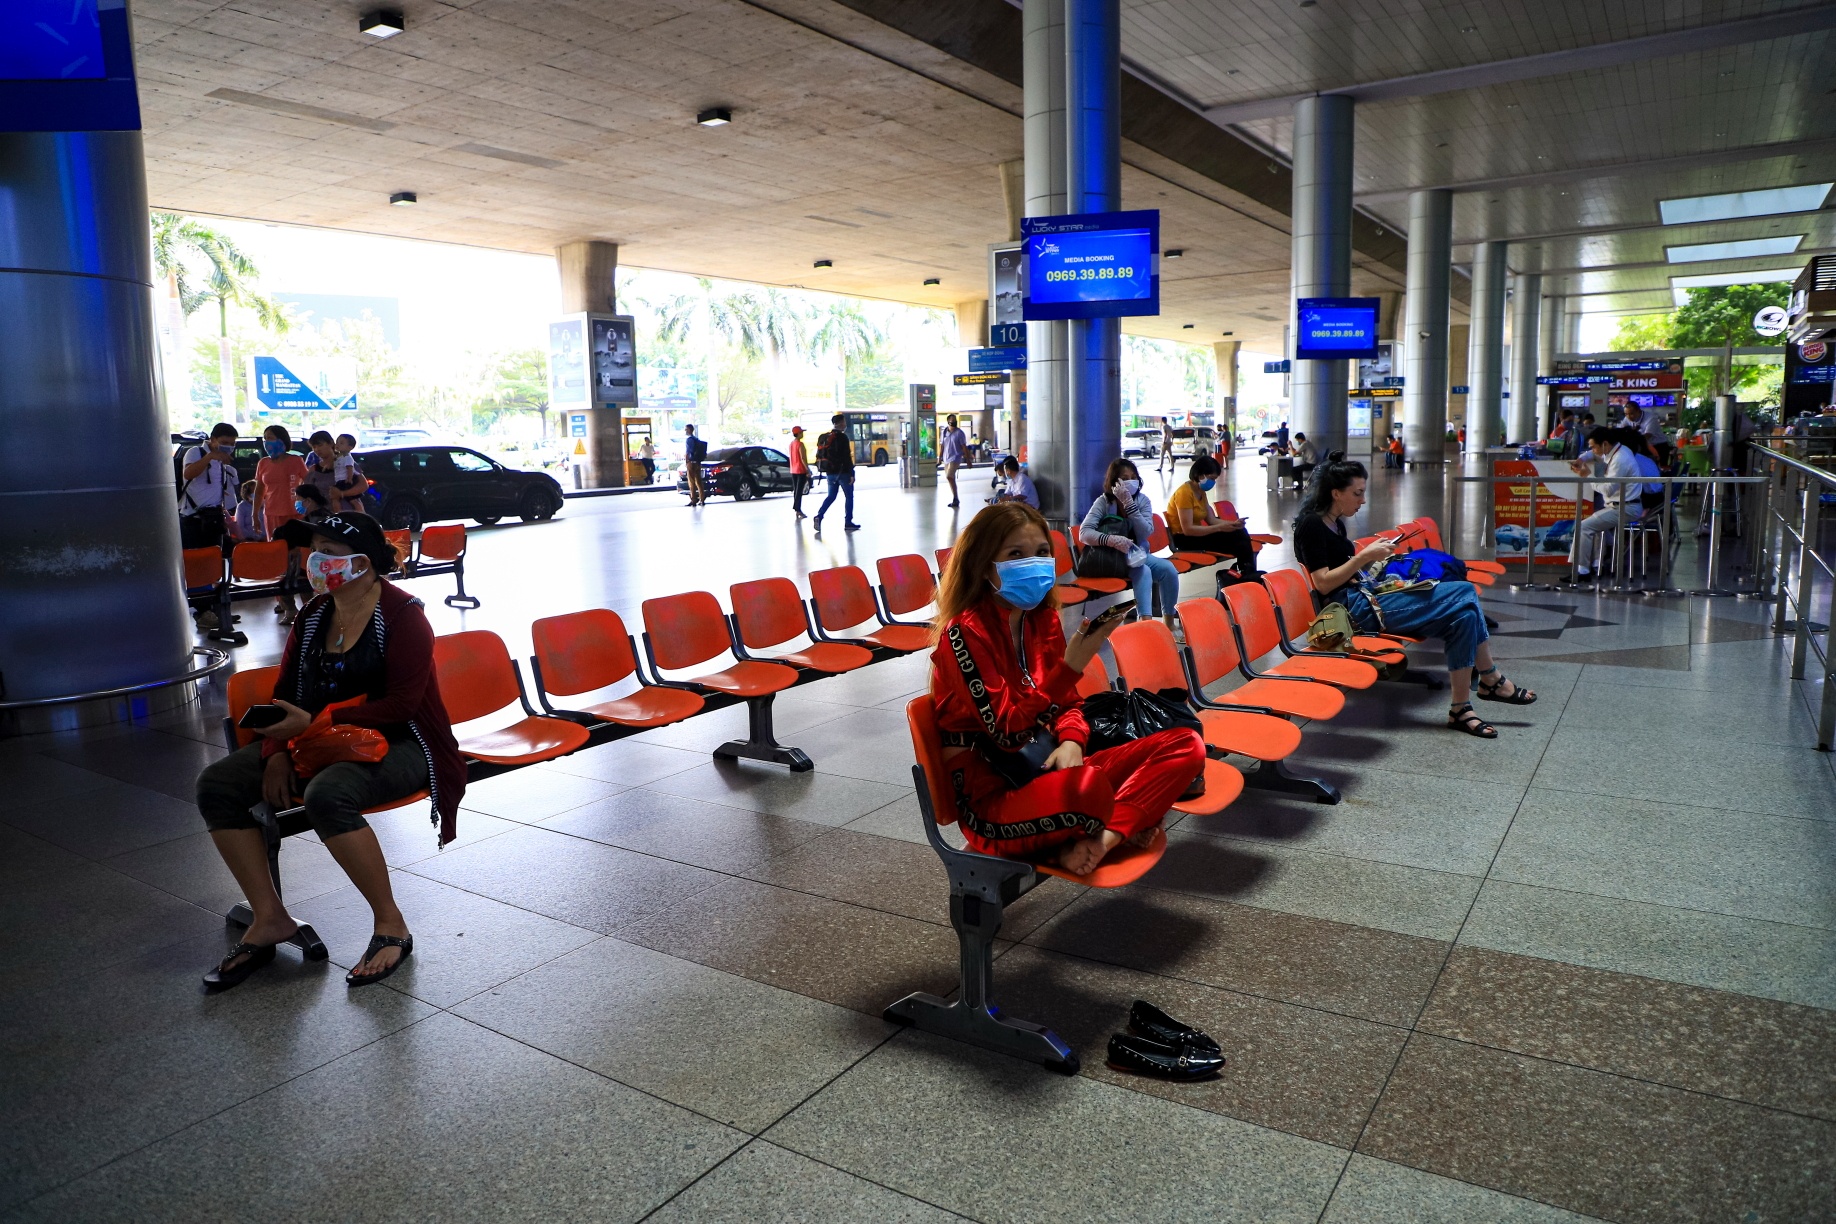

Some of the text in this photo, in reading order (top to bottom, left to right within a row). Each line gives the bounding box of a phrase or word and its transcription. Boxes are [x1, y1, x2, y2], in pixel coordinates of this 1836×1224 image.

[1085, 255, 1115, 263] BOOKING
[1046, 266, 1134, 283] 0969.39.89.89
[1000, 326, 1019, 342] 10
[1311, 329, 1365, 338] 0969.39.89.89
[1803, 346, 1825, 358] KING
[1388, 378, 1399, 386] 12
[1578, 379, 1624, 389] BER
[1627, 378, 1658, 388] KING
[948, 625, 975, 673] GUCC
[1001, 822, 1037, 839] GUCCI
